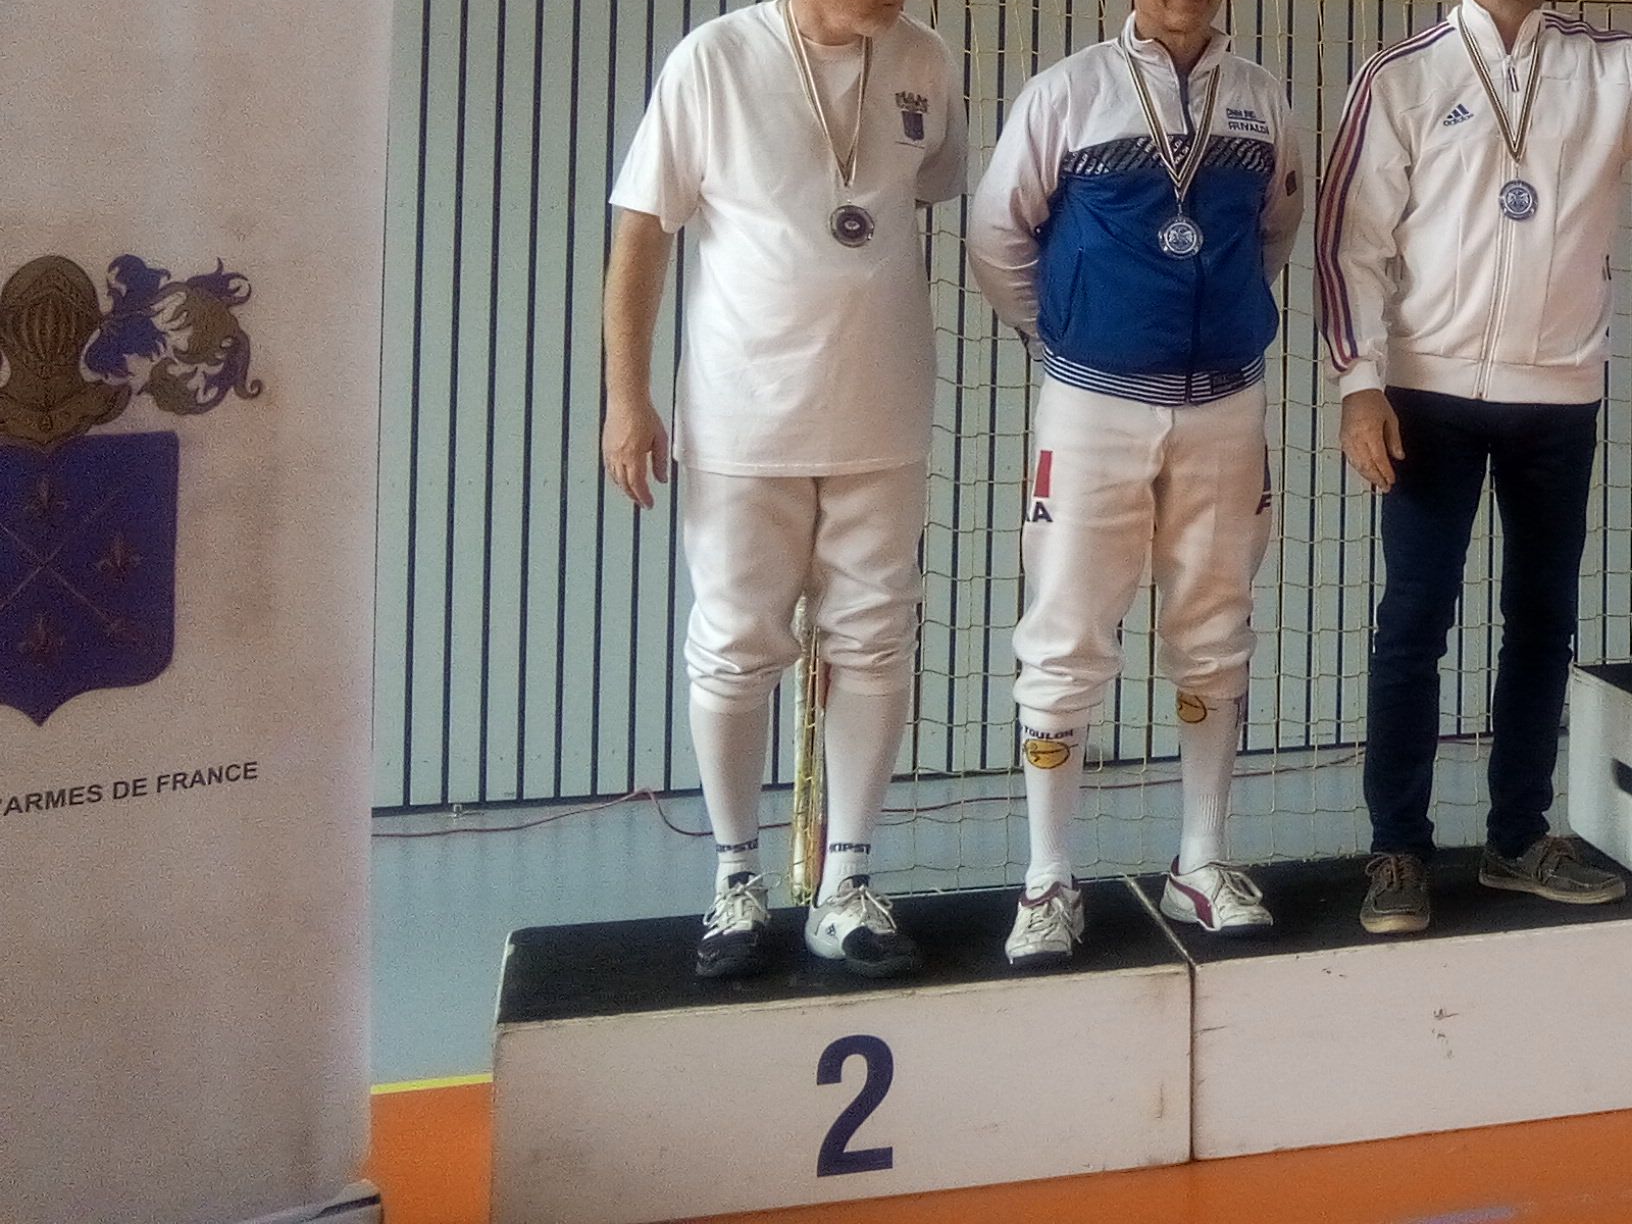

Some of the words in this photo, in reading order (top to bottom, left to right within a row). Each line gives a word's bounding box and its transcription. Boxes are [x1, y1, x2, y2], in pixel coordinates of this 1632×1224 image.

[112, 777, 148, 801] DE
[156, 760, 259, 794] FRANCE
[816, 1034, 895, 1178] 2
